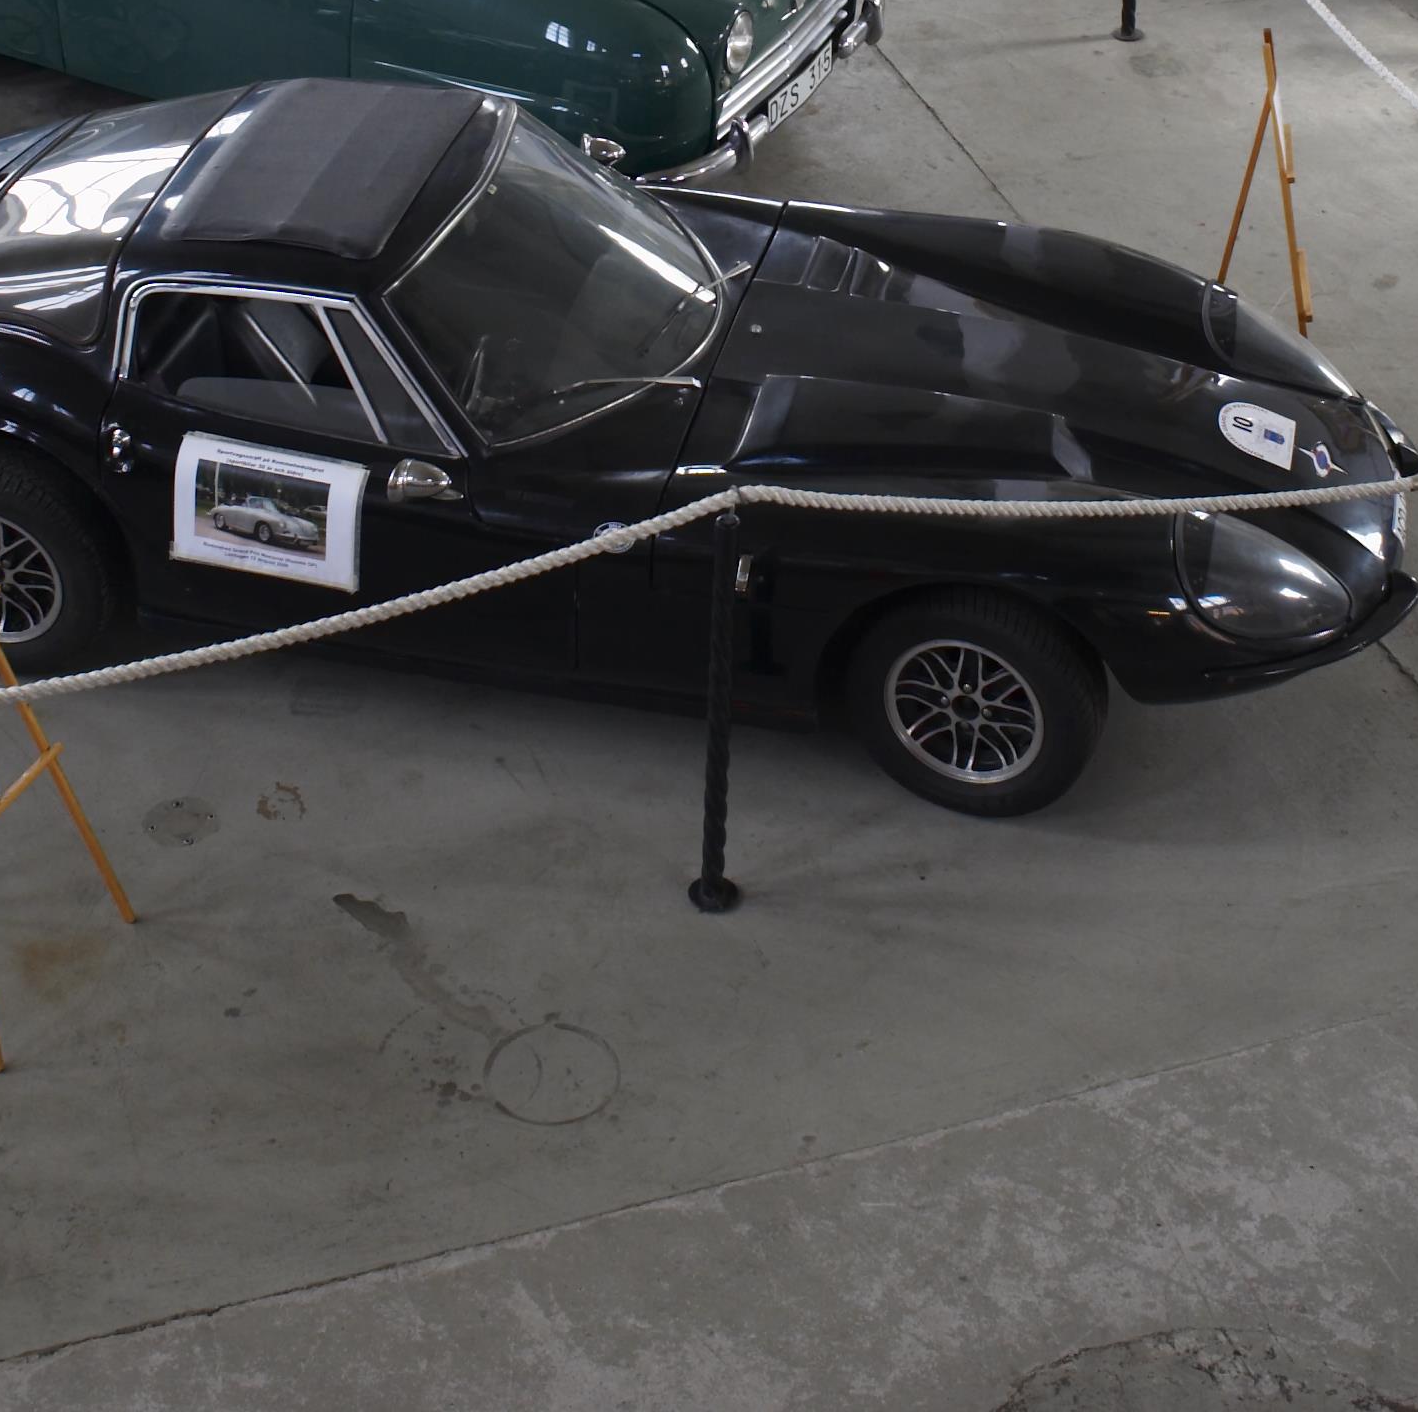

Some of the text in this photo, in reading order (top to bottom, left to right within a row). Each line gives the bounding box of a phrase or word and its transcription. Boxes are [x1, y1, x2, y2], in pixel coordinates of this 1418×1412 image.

[770, 48, 831, 126] DZS 315
[1232, 416, 1254, 433] 10
